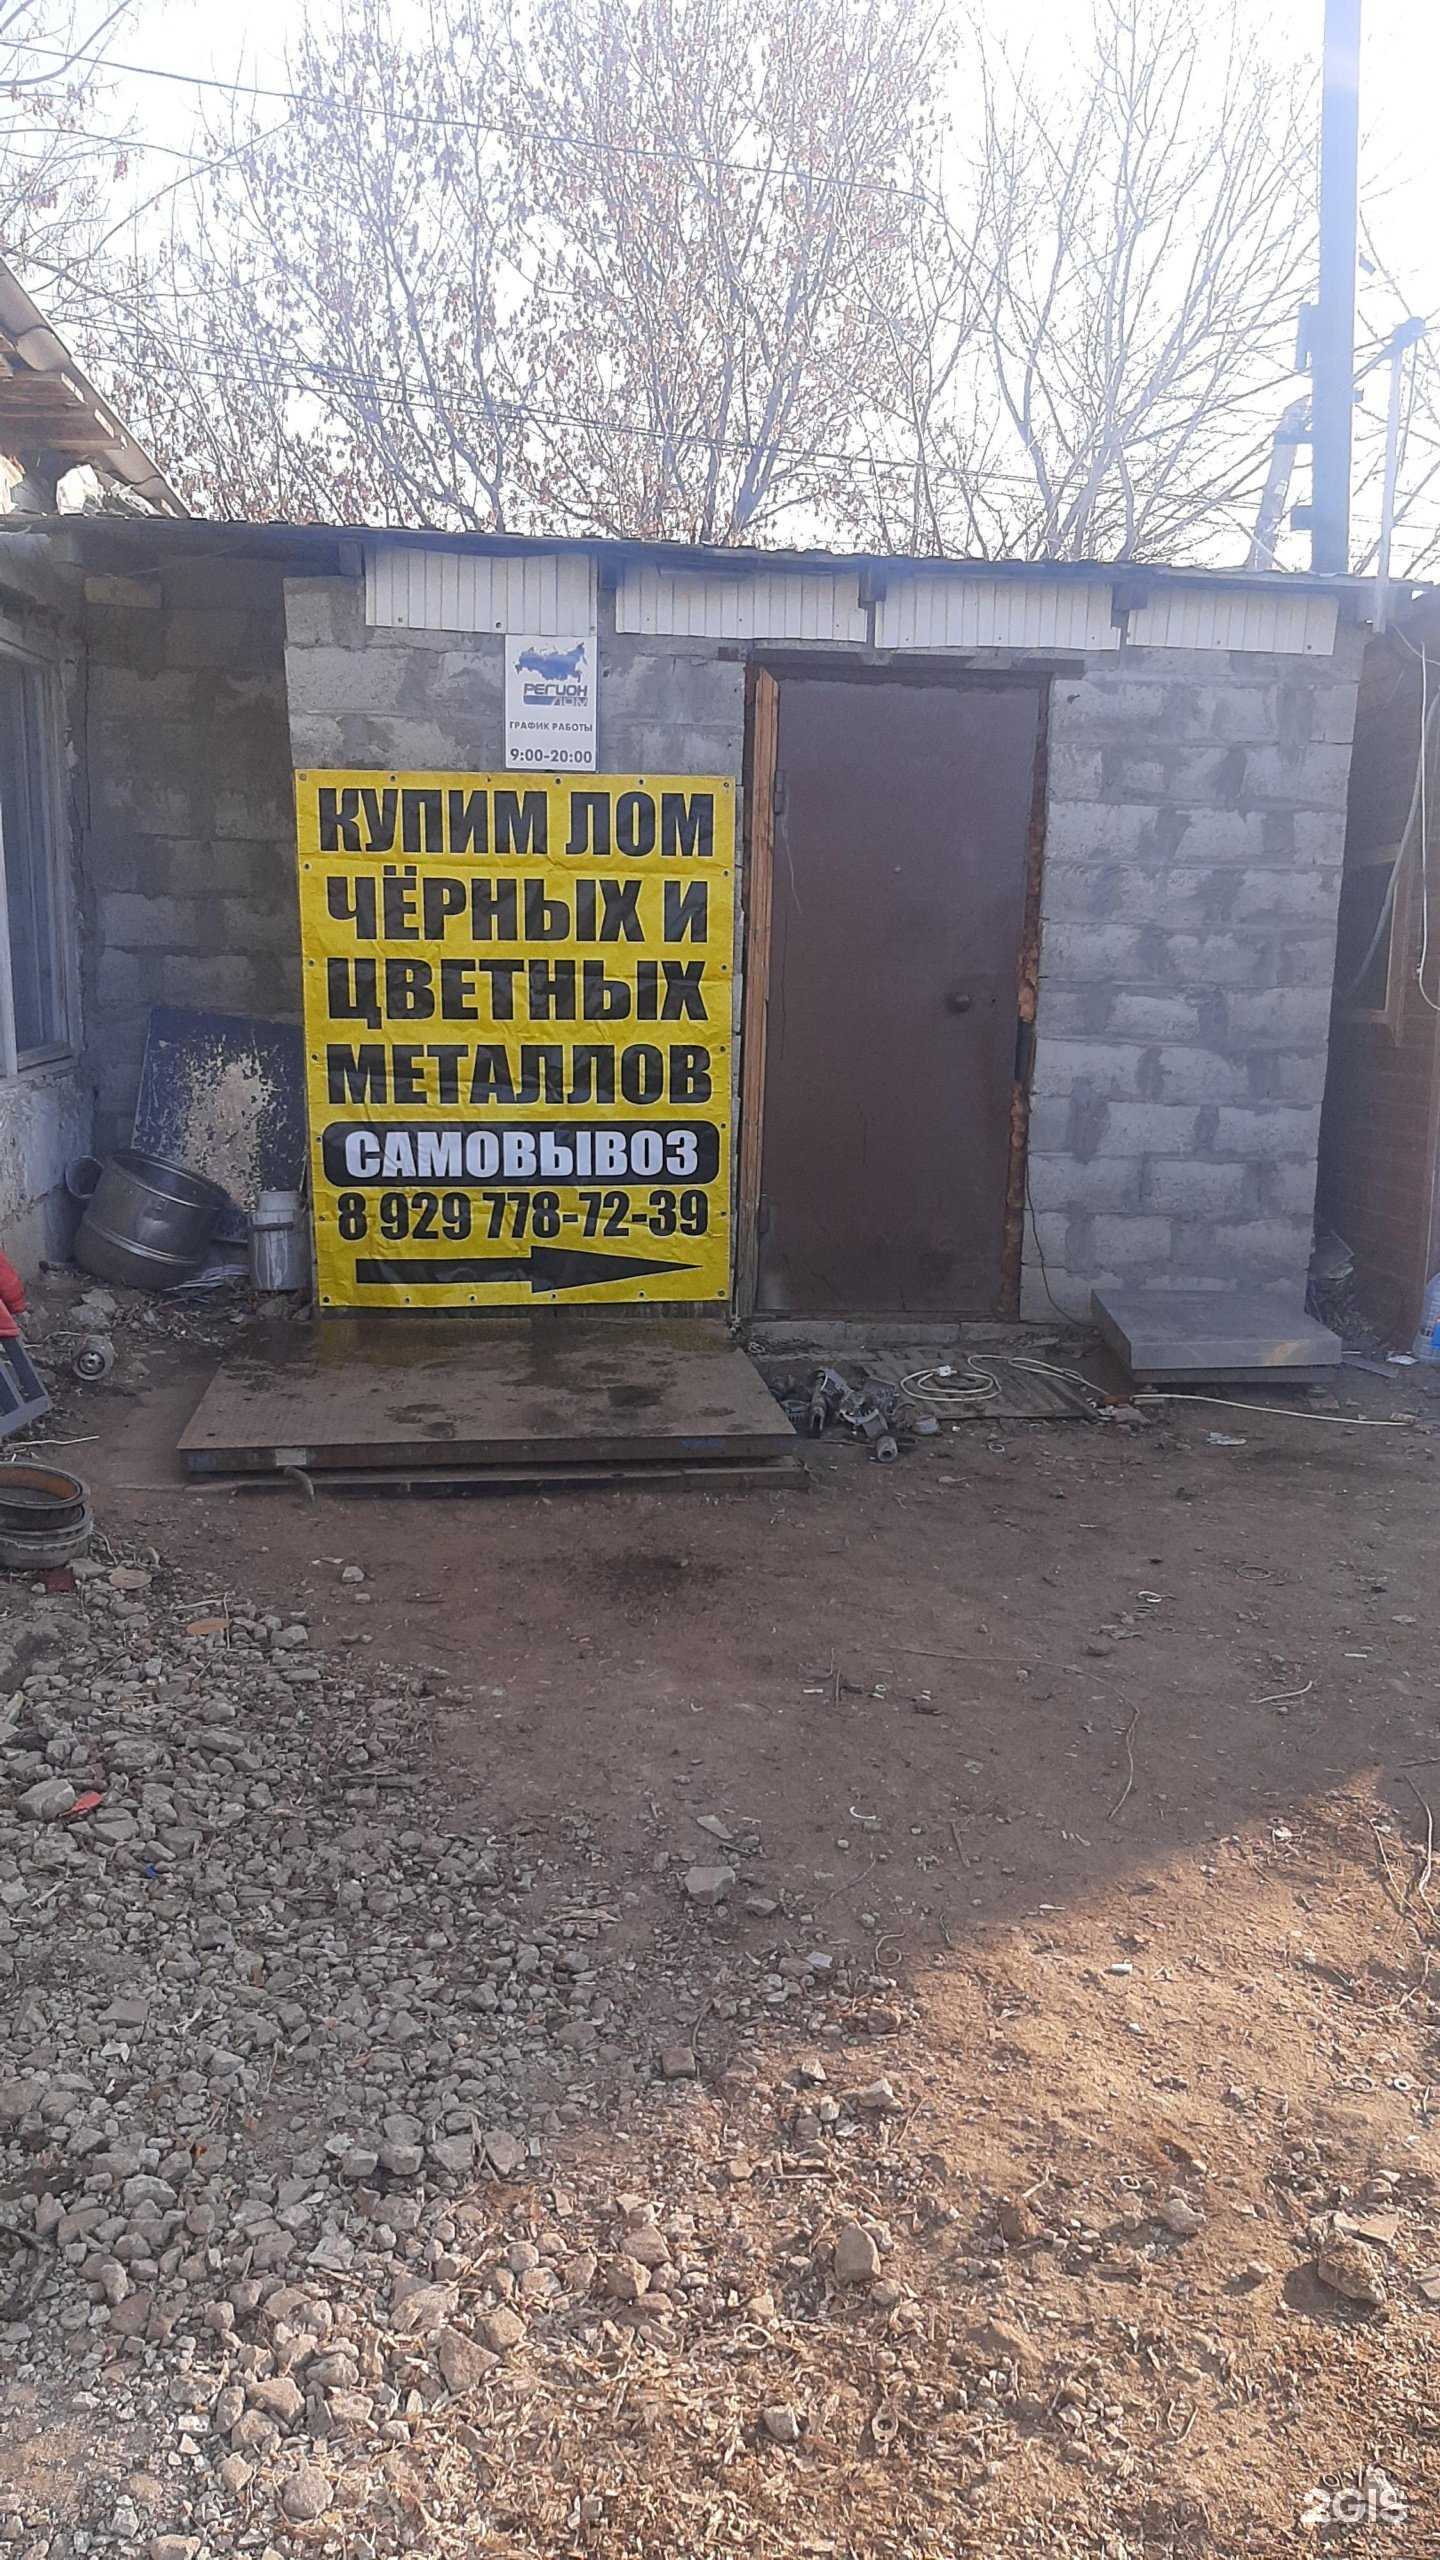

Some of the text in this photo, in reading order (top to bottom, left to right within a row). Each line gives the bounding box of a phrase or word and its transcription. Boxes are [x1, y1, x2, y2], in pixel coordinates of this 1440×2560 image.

[524, 683, 588, 696] РЕГИОН
[509, 721, 593, 732] ГРАФИК РАБОТЫ
[510, 748, 592, 763] 9:00-20:00
[318, 788, 714, 857] КУПИМ ЛОМ
[327, 865, 708, 943] ЧЁРНЫХ И
[327, 957, 708, 1030] ЦВЕТНЫХ
[326, 1044, 711, 1104] МЕТАЛЛОВ
[345, 1130, 698, 1178] САМОВЫВОЗ
[338, 1189, 709, 1240] 8 929 778-72-39
